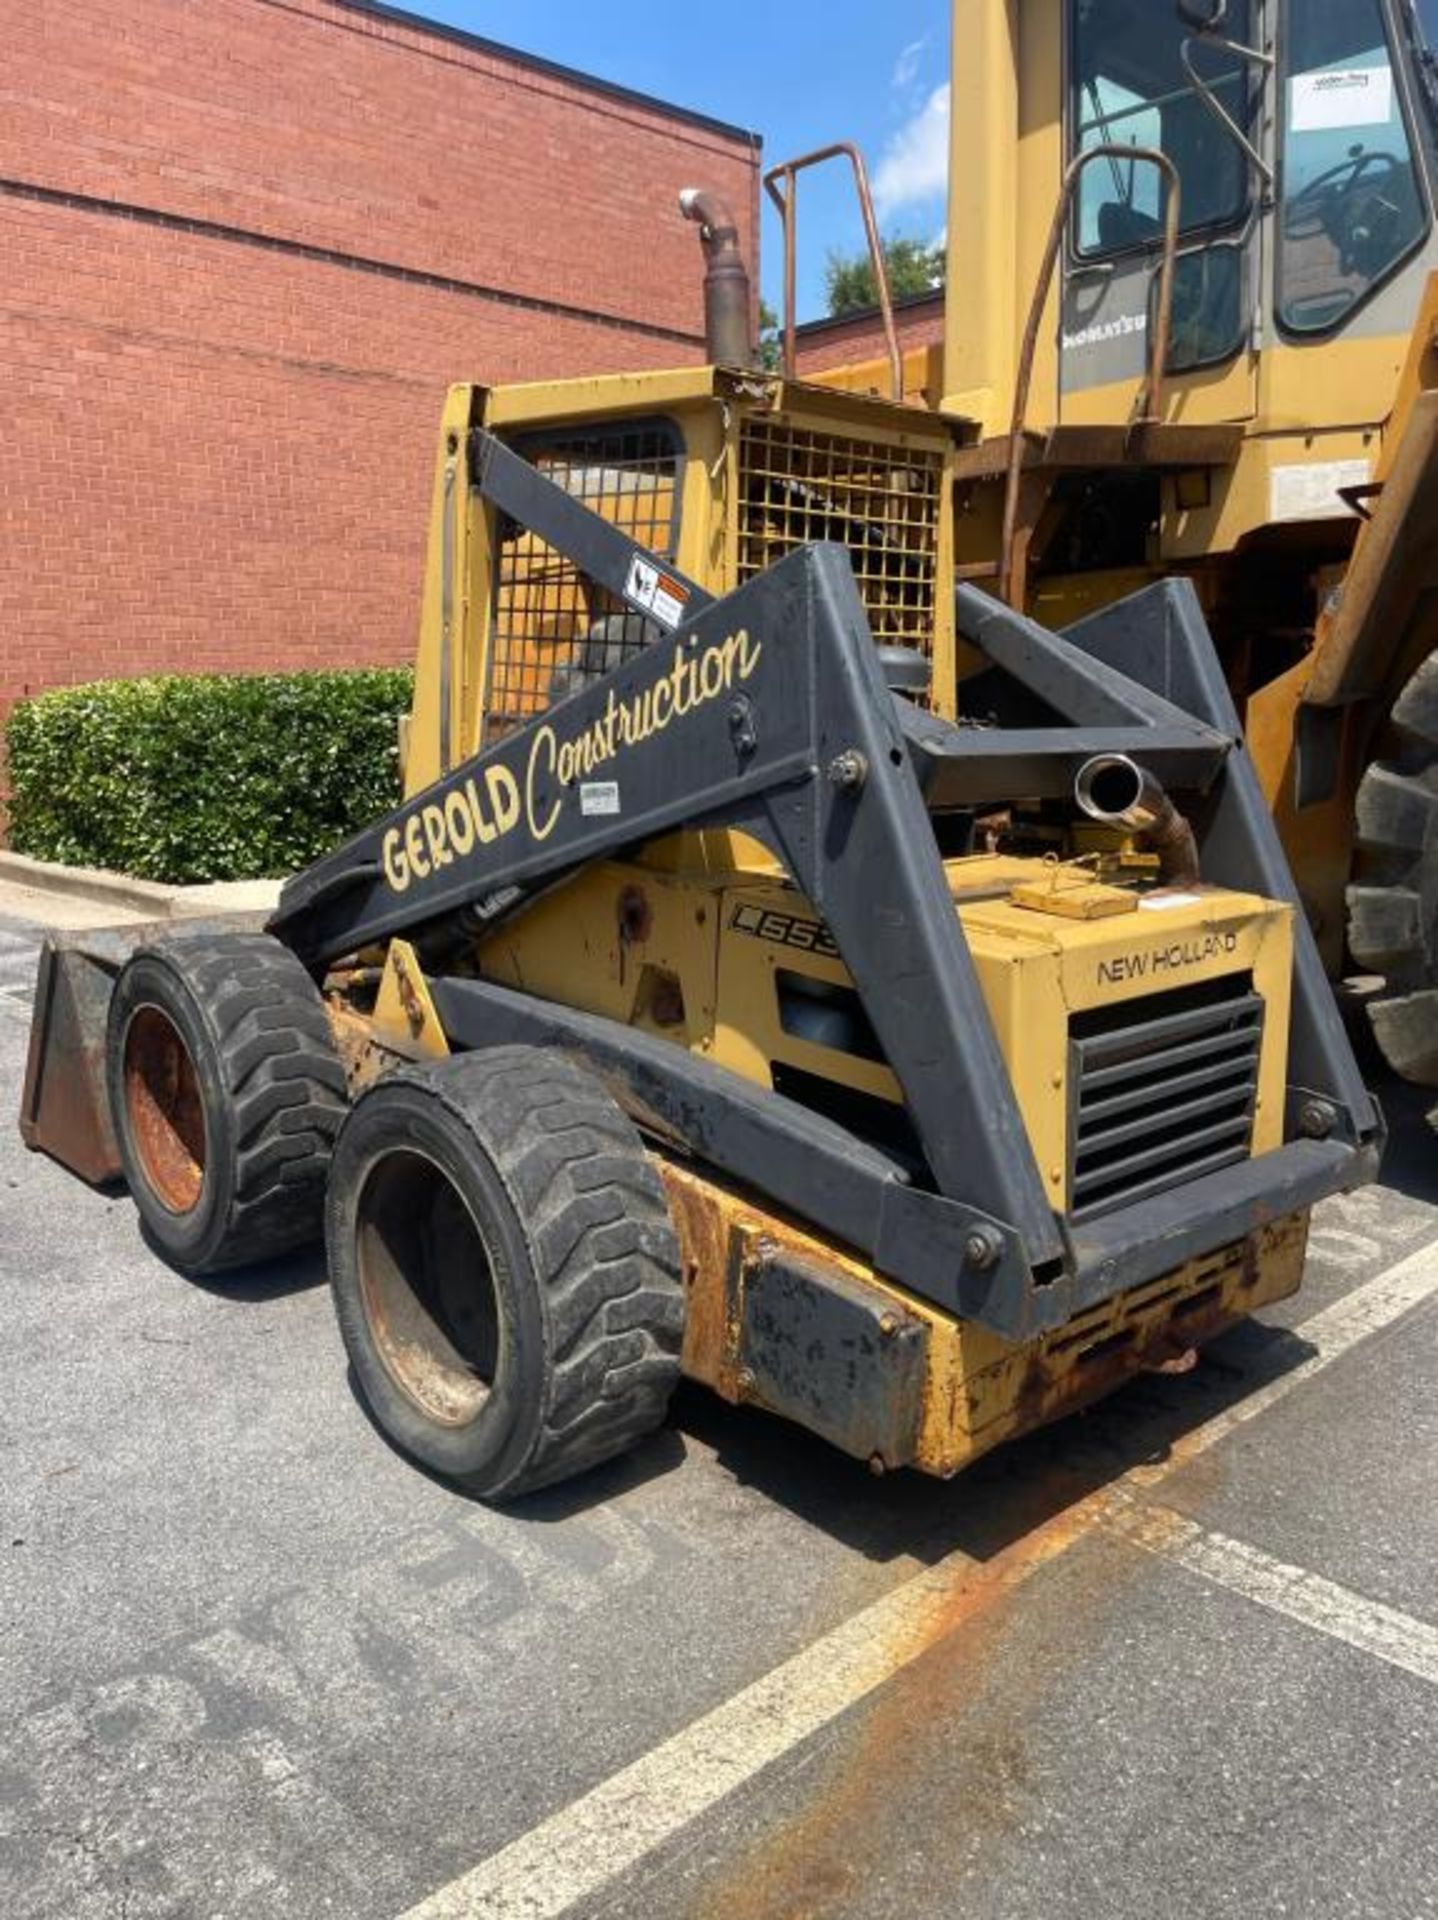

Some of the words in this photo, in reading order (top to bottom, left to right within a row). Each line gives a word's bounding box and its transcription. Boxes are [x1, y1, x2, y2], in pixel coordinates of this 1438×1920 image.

[381, 763, 521, 892] GEROLD
[526, 628, 762, 841] Construction
[1097, 952, 1149, 986] NEW
[1151, 932, 1237, 974] HOLLAND
